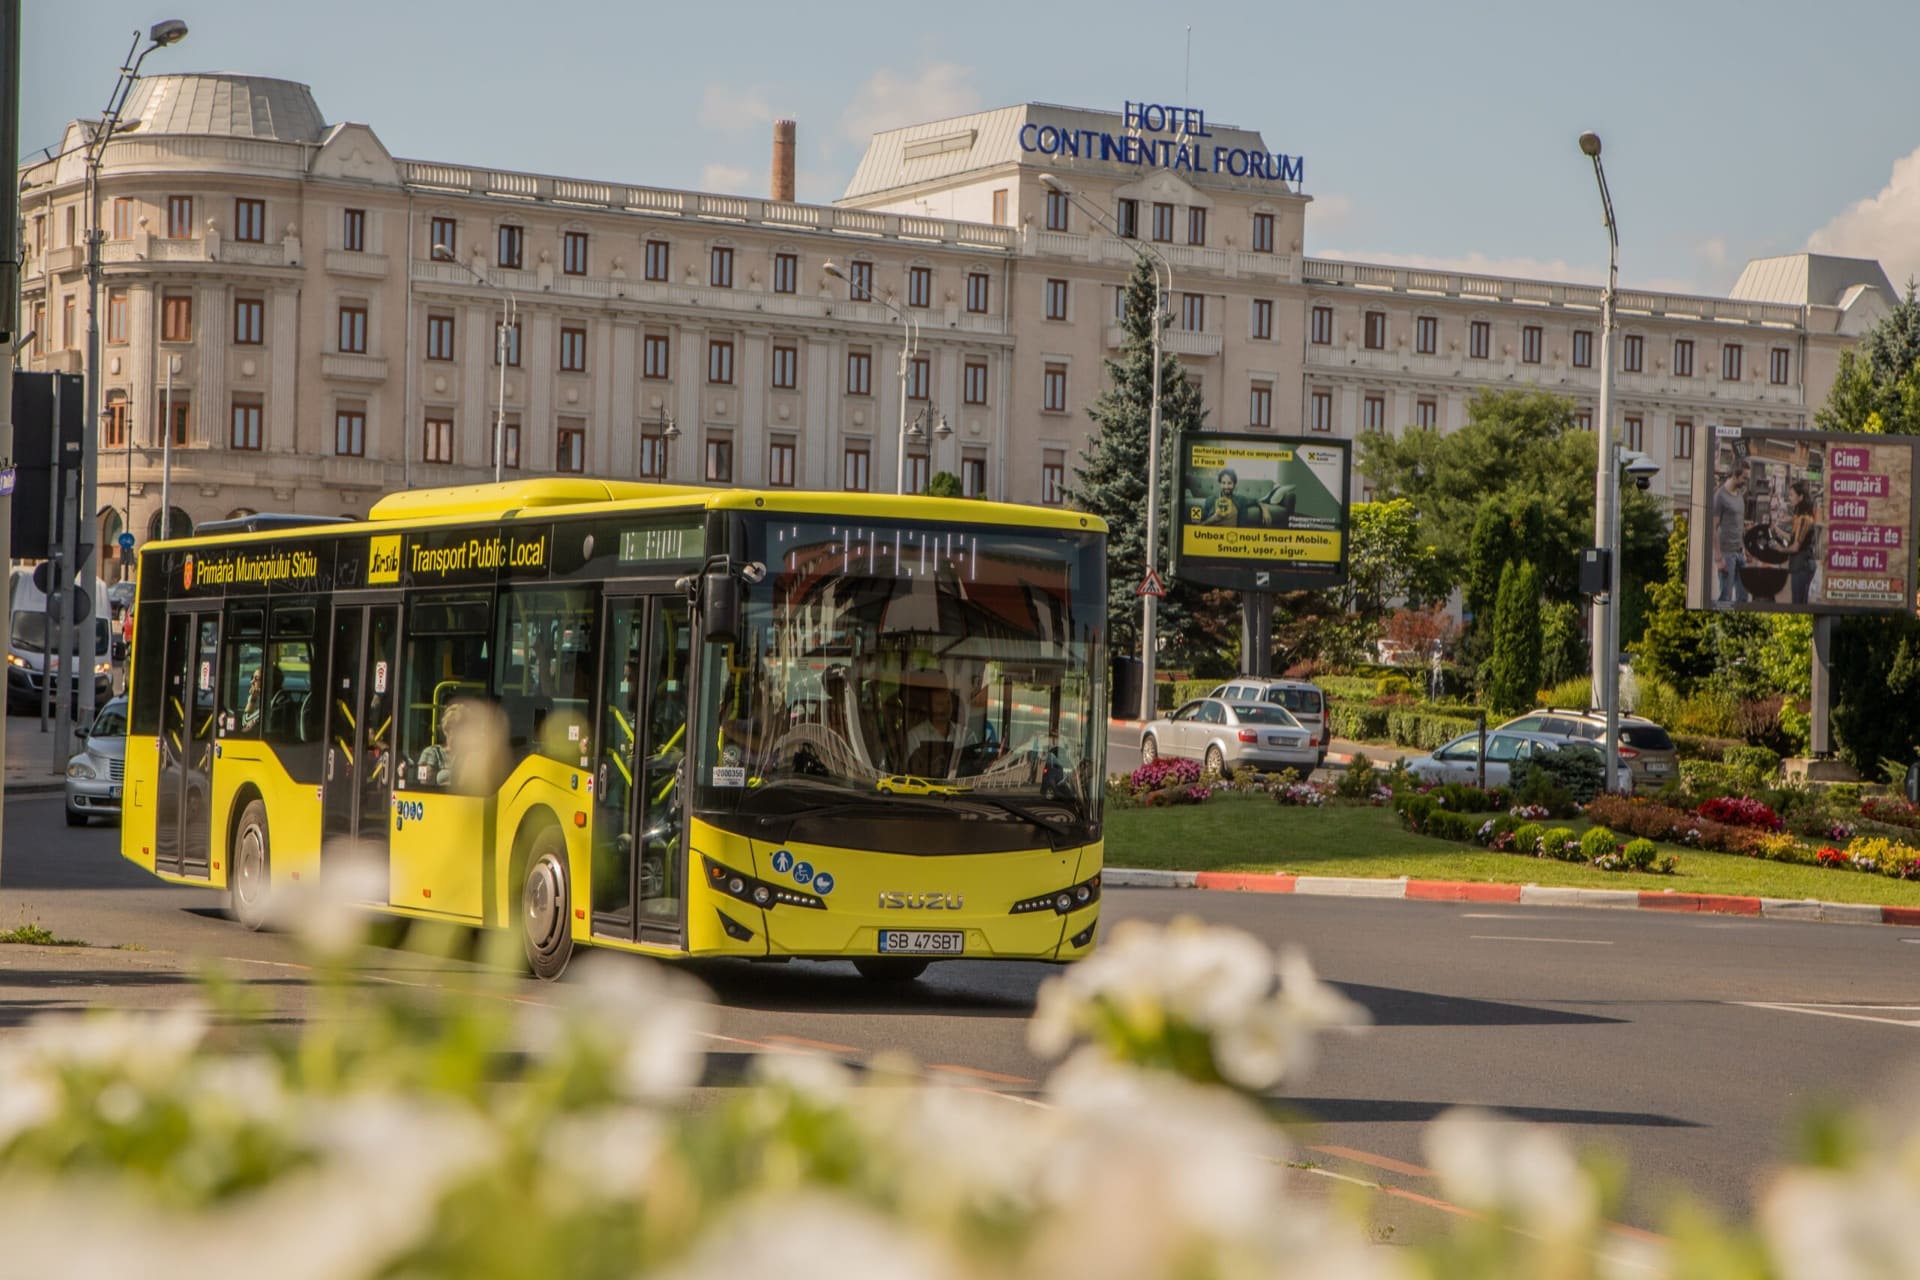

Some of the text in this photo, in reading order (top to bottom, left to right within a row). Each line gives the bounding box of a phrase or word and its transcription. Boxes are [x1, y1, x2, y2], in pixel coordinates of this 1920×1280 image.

[1123, 101, 1212, 138] HOTEL
[1019, 124, 1304, 183] CONTINENTAL FORUM
[1834, 451, 1861, 468] Cine
[1833, 477, 1882, 496] cumpără
[1832, 501, 1866, 519] ieftin
[1194, 531, 1332, 545] Unbox noul Smart Mobile.
[1832, 527, 1899, 546] cumpără de
[411, 535, 545, 577] Transport Public Local
[1217, 544, 1250, 555] Smart,
[1280, 546, 1308, 558] sigur.
[1831, 551, 1884, 568] două ori.
[196, 550, 318, 587] Primăria Municipiului Sibiu
[1827, 577, 1890, 591] HORNBACH
[878, 891, 964, 910] ISUZU
[888, 933, 960, 950] SB 47SBT
